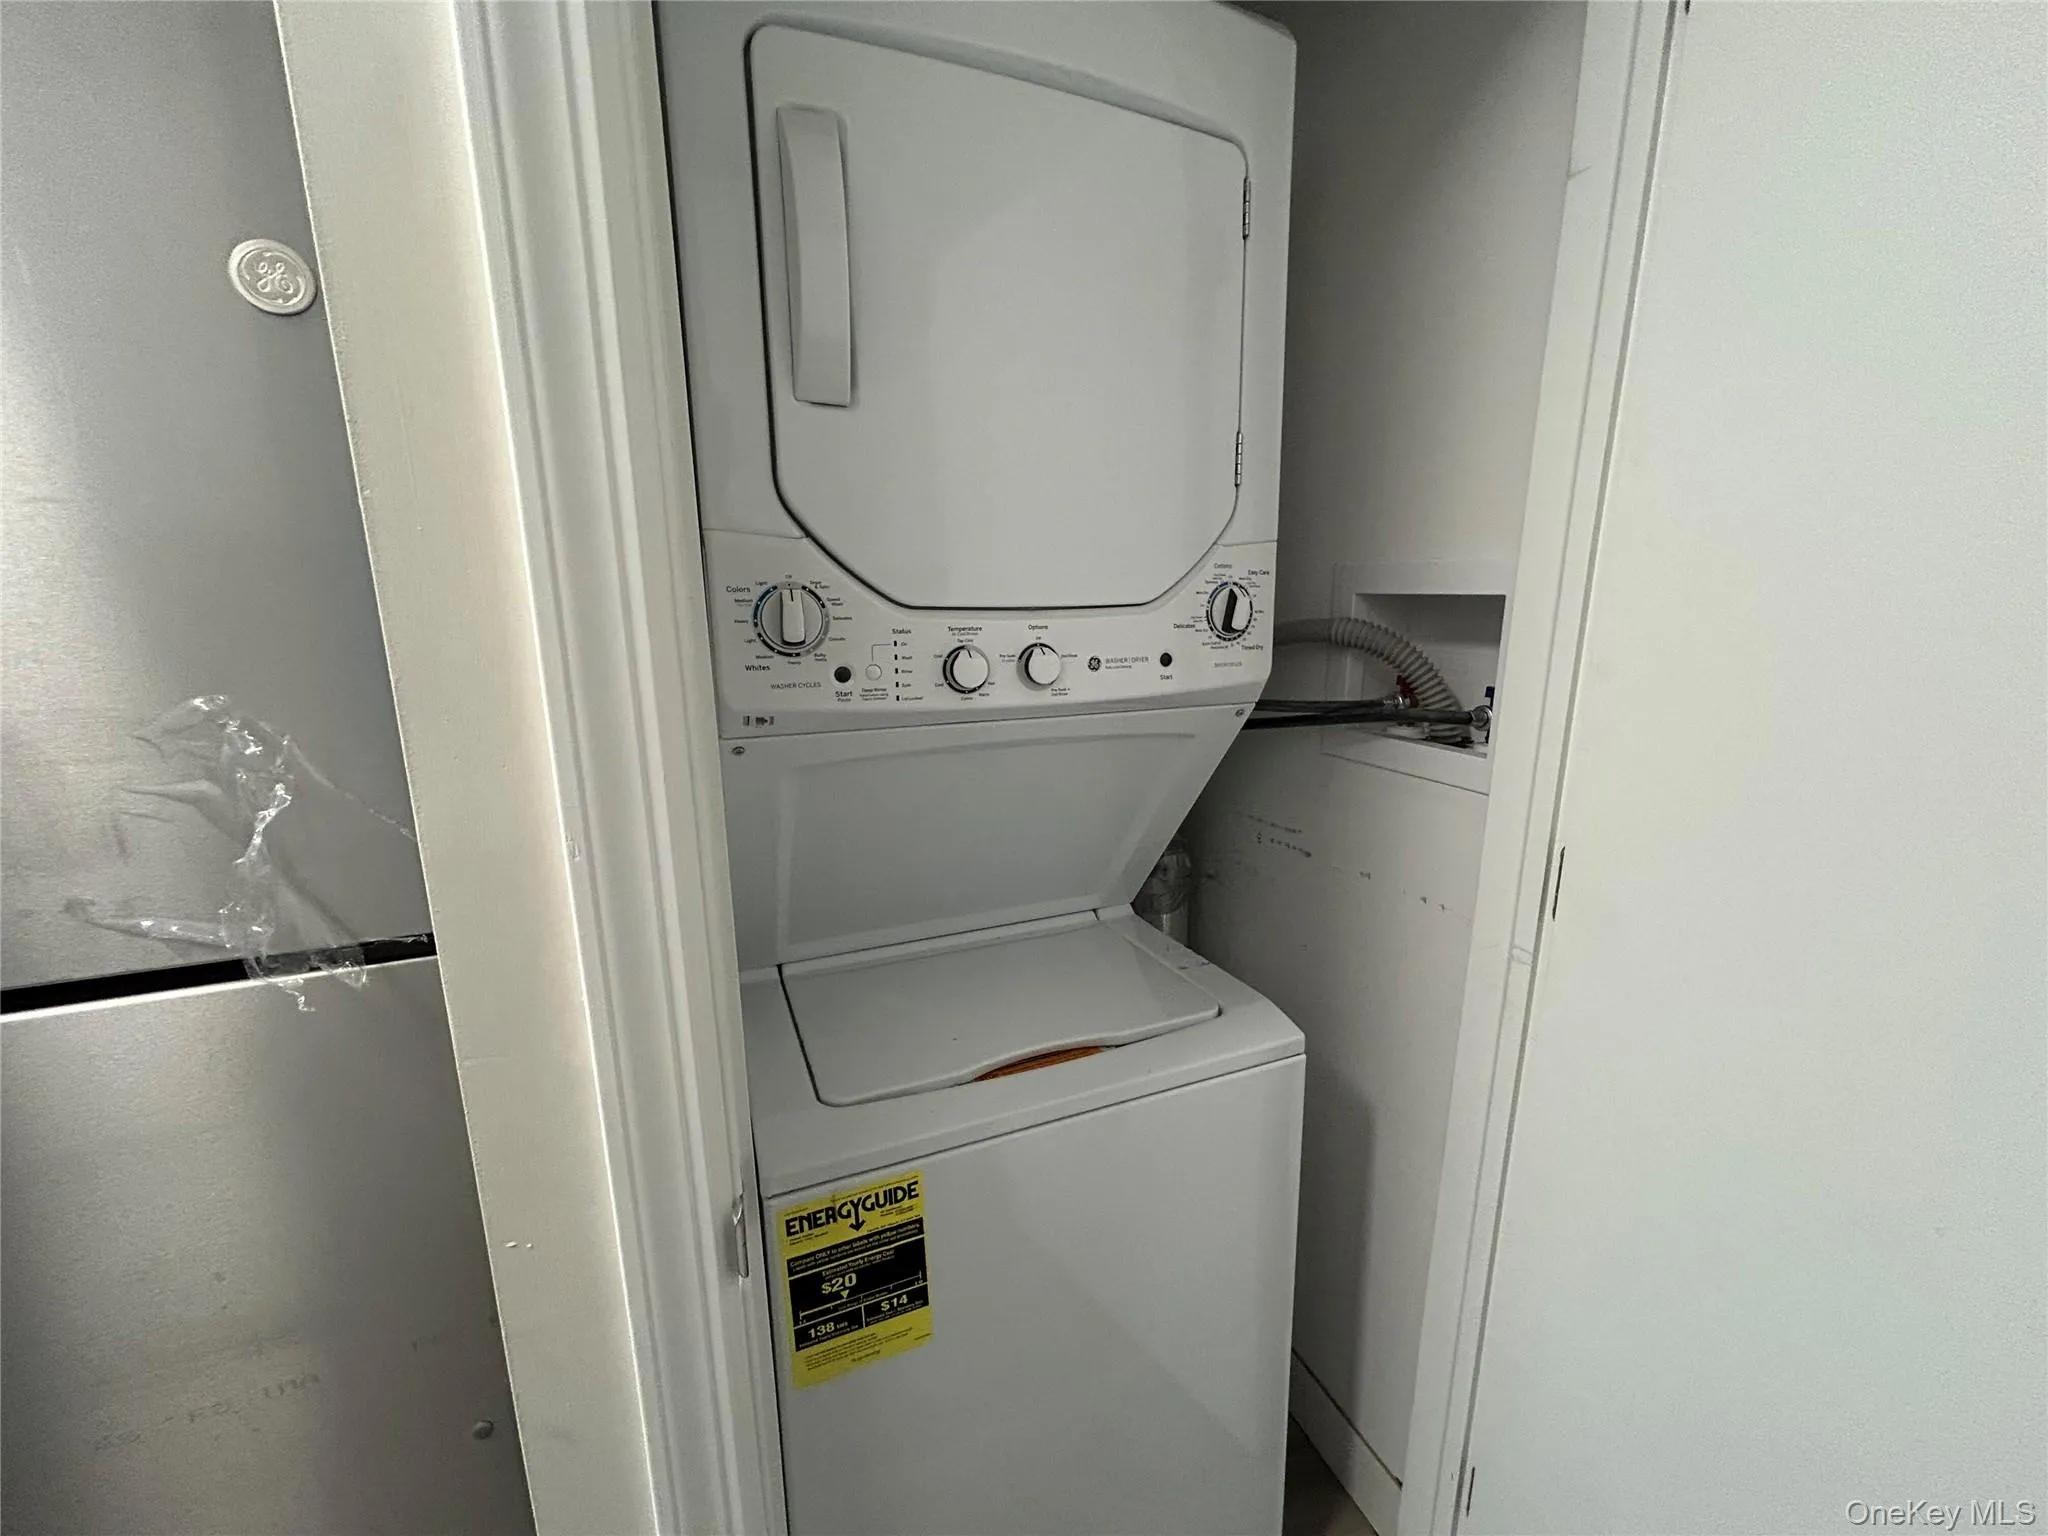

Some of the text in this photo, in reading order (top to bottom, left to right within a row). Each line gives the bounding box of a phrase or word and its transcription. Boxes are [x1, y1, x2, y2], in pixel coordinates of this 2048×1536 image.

[785, 1180, 919, 1237] ENERGYGUIDE
[821, 1273, 857, 1294] $20
[880, 1294, 908, 1312] $14
[808, 1322, 835, 1339] 138
